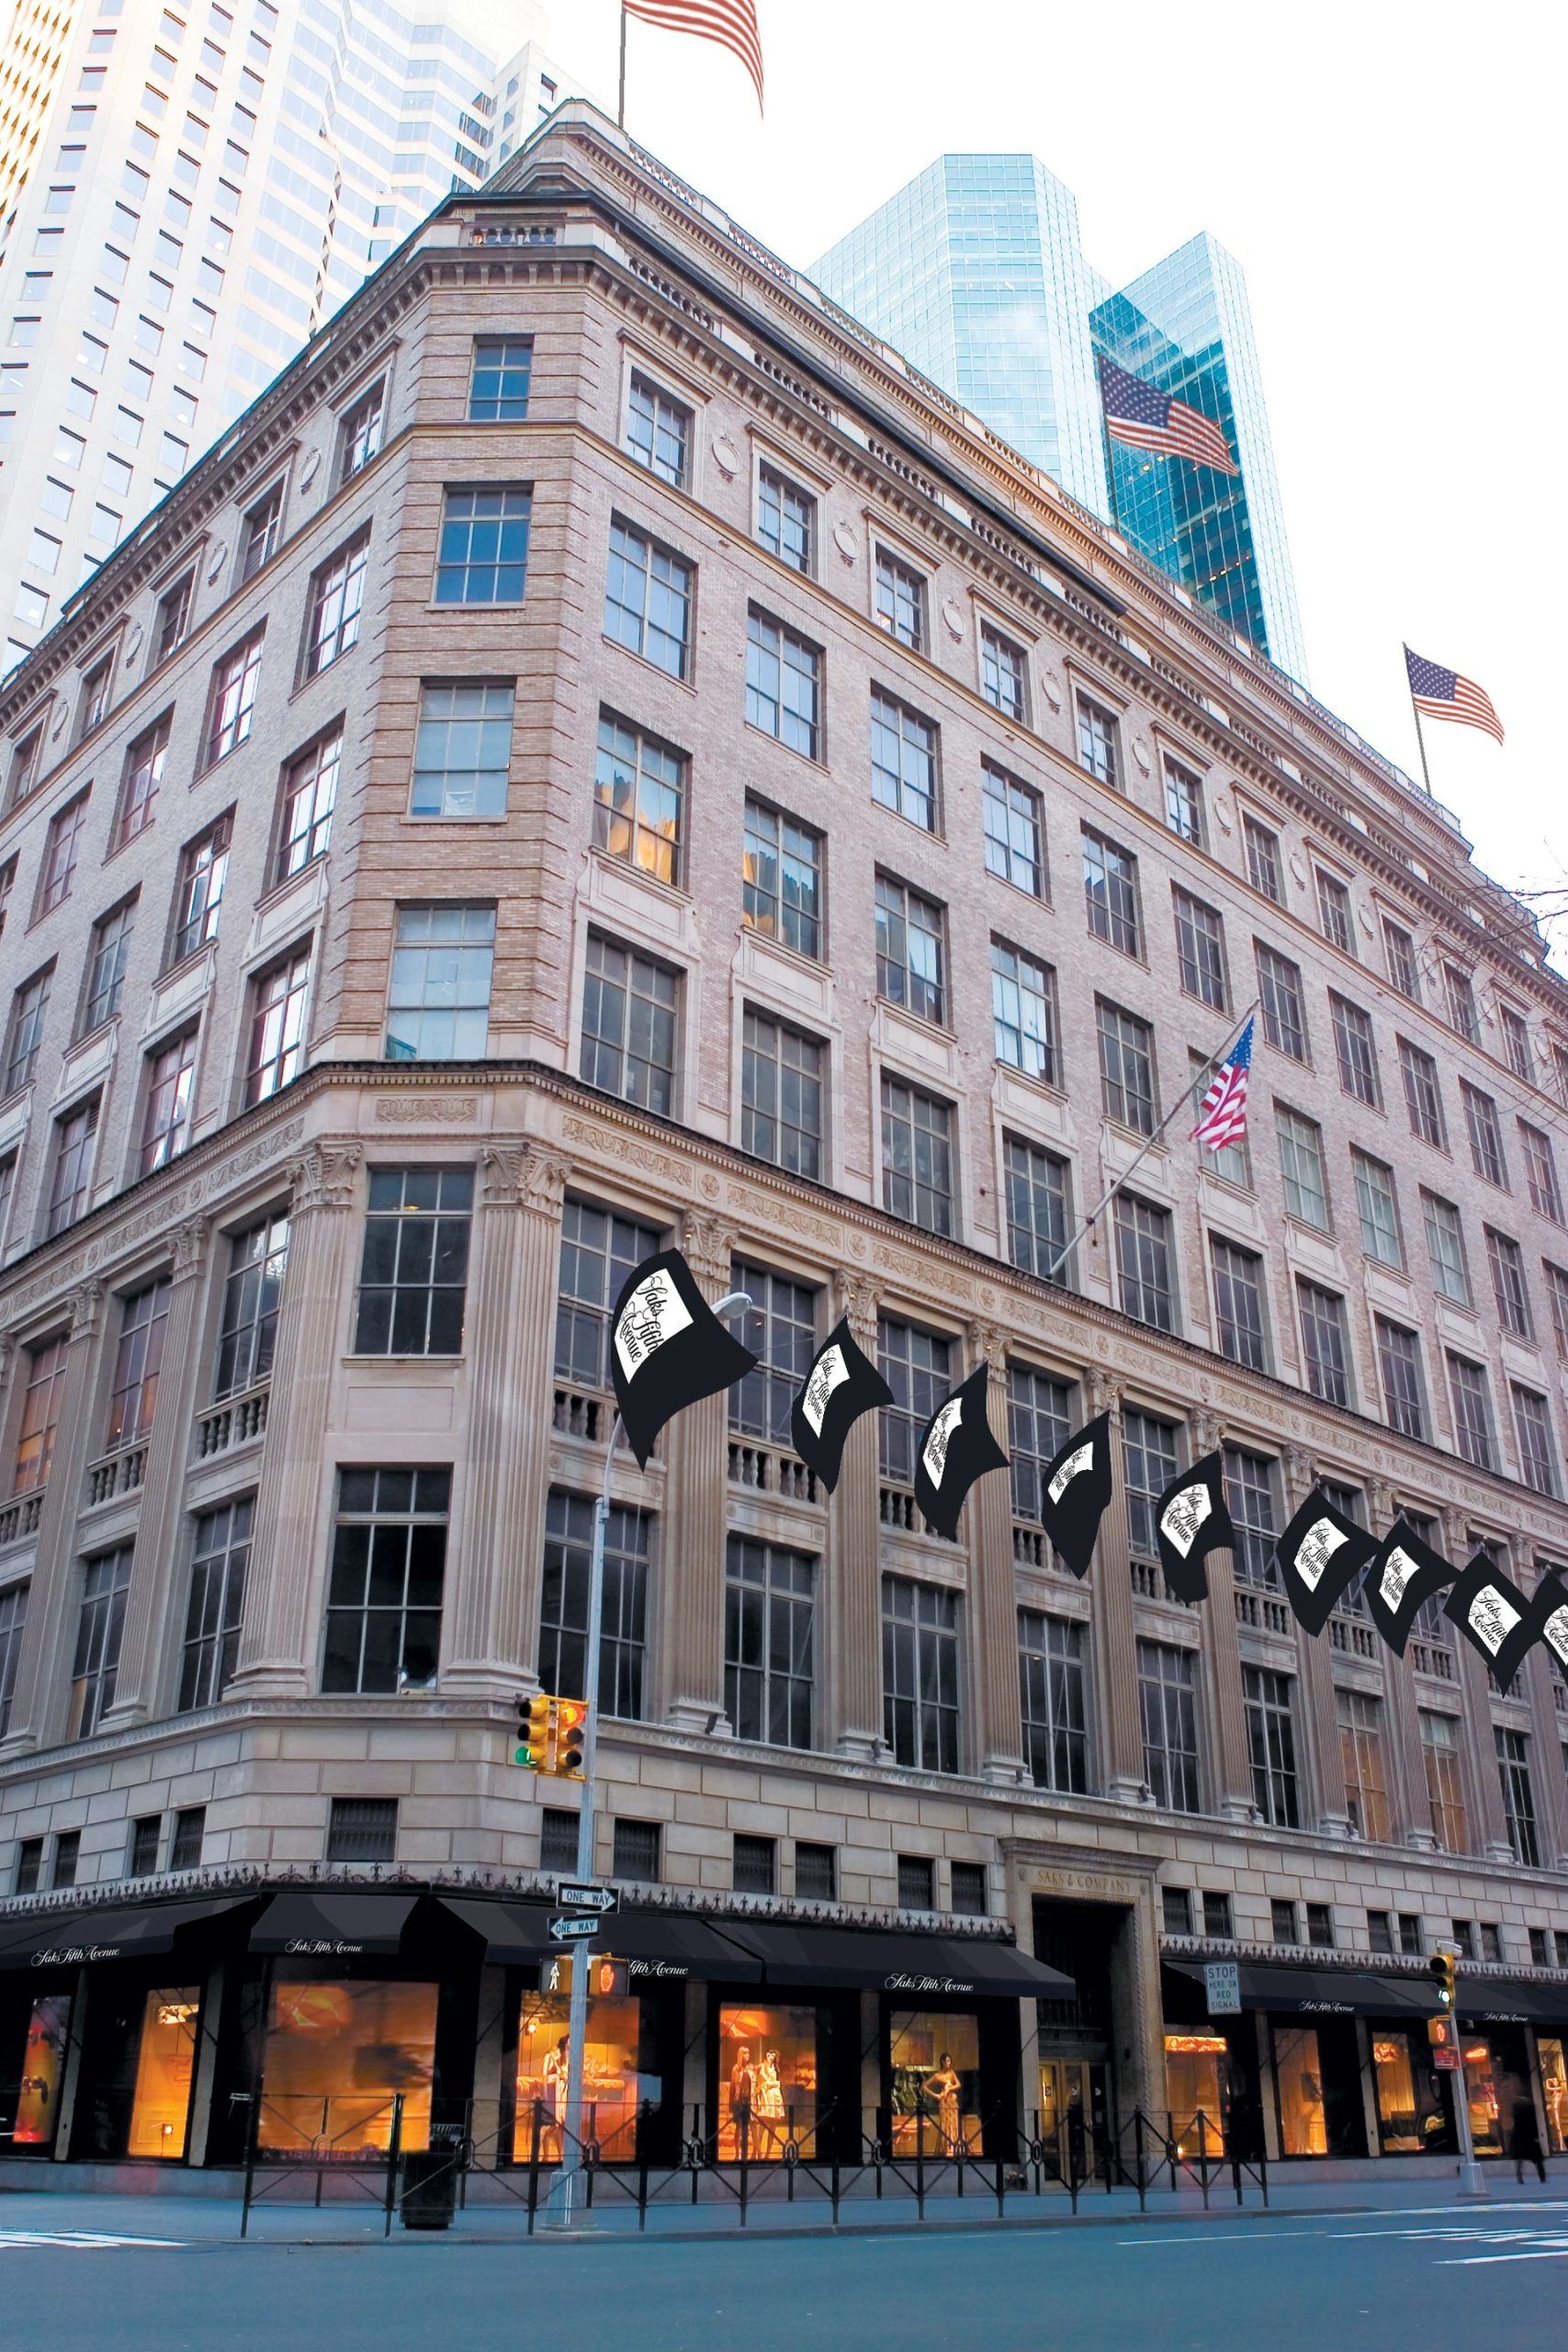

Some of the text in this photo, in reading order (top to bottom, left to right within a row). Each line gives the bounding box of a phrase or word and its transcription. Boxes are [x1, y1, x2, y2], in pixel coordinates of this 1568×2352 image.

[636, 1276, 668, 1317] Saks
[619, 1301, 642, 1363] Avenue
[632, 1307, 664, 1354] Fifth
[1163, 1499, 1191, 1544] Avenue
[1298, 1539, 1321, 1578] Avenue
[1475, 1590, 1502, 1619] Saks
[1470, 1605, 1499, 1646] Avenue
[1038, 1870, 1132, 1893] SAKS & COMPANY
[567, 1891, 611, 1905] ONE WAY
[556, 1920, 595, 1934] ONE WAY
[31, 1945, 120, 1967] Saks Fifth Avenue
[285, 1938, 362, 1954] Saks Fifth Avenue
[647, 1960, 689, 1976] Avenue
[1208, 1966, 1235, 1978] STOP
[885, 1973, 974, 1992] Saks Fifth Avenue
[1209, 1980, 1224, 1989] HERE
[1216, 1990, 1230, 1999] RED
[1211, 2001, 1237, 2009] SIGNAL
